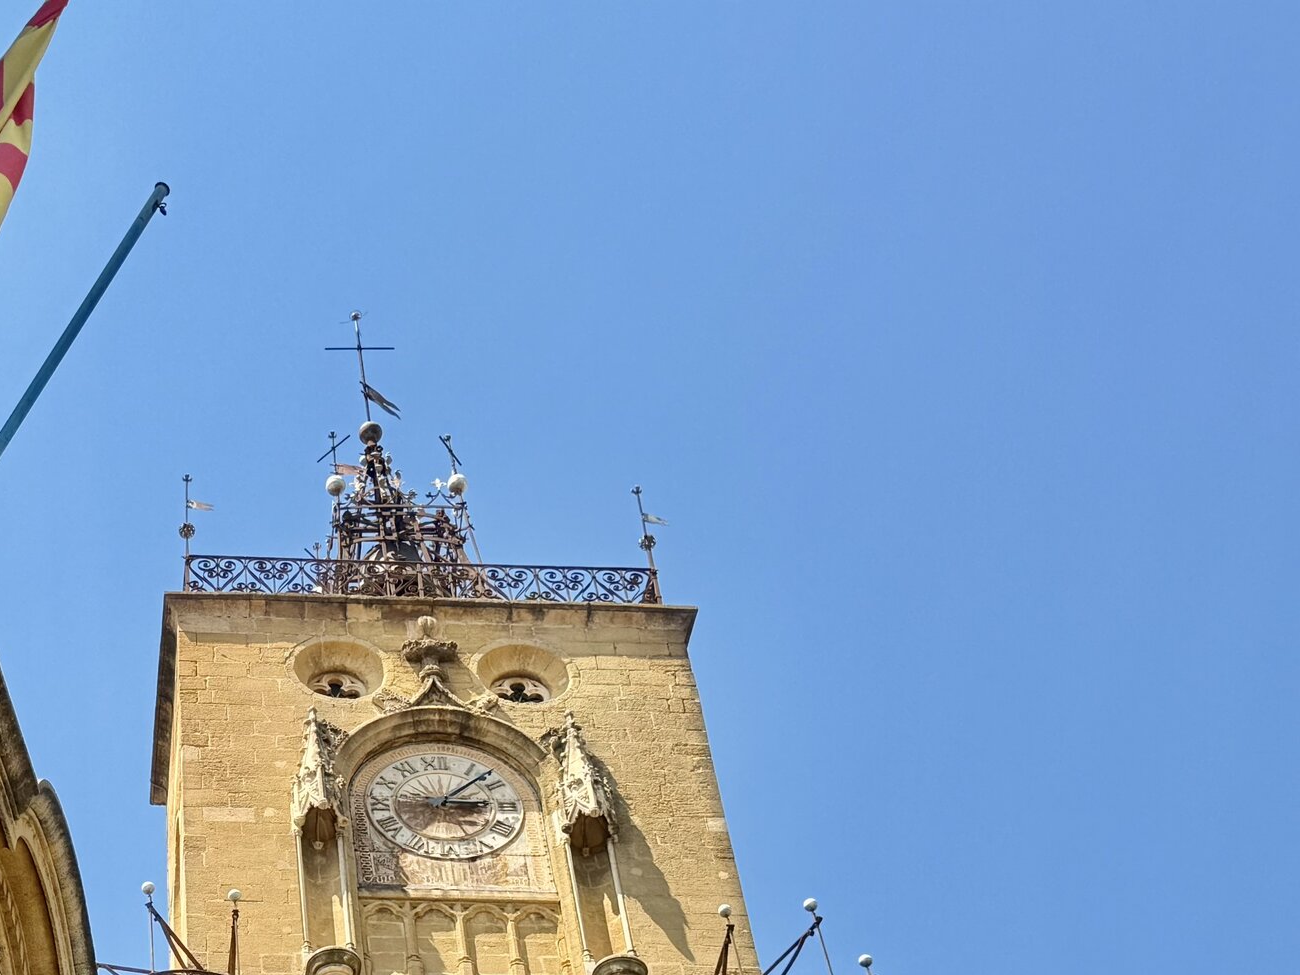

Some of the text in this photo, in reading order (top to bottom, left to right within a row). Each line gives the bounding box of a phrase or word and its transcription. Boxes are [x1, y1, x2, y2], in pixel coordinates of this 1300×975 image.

[392, 761, 419, 778] XI
[420, 757, 449, 771] XII
[463, 763, 476, 776] I
[376, 776, 397, 791] X
[485, 780, 505, 791] II
[370, 789, 390, 814] IX
[497, 801, 517, 813] III
